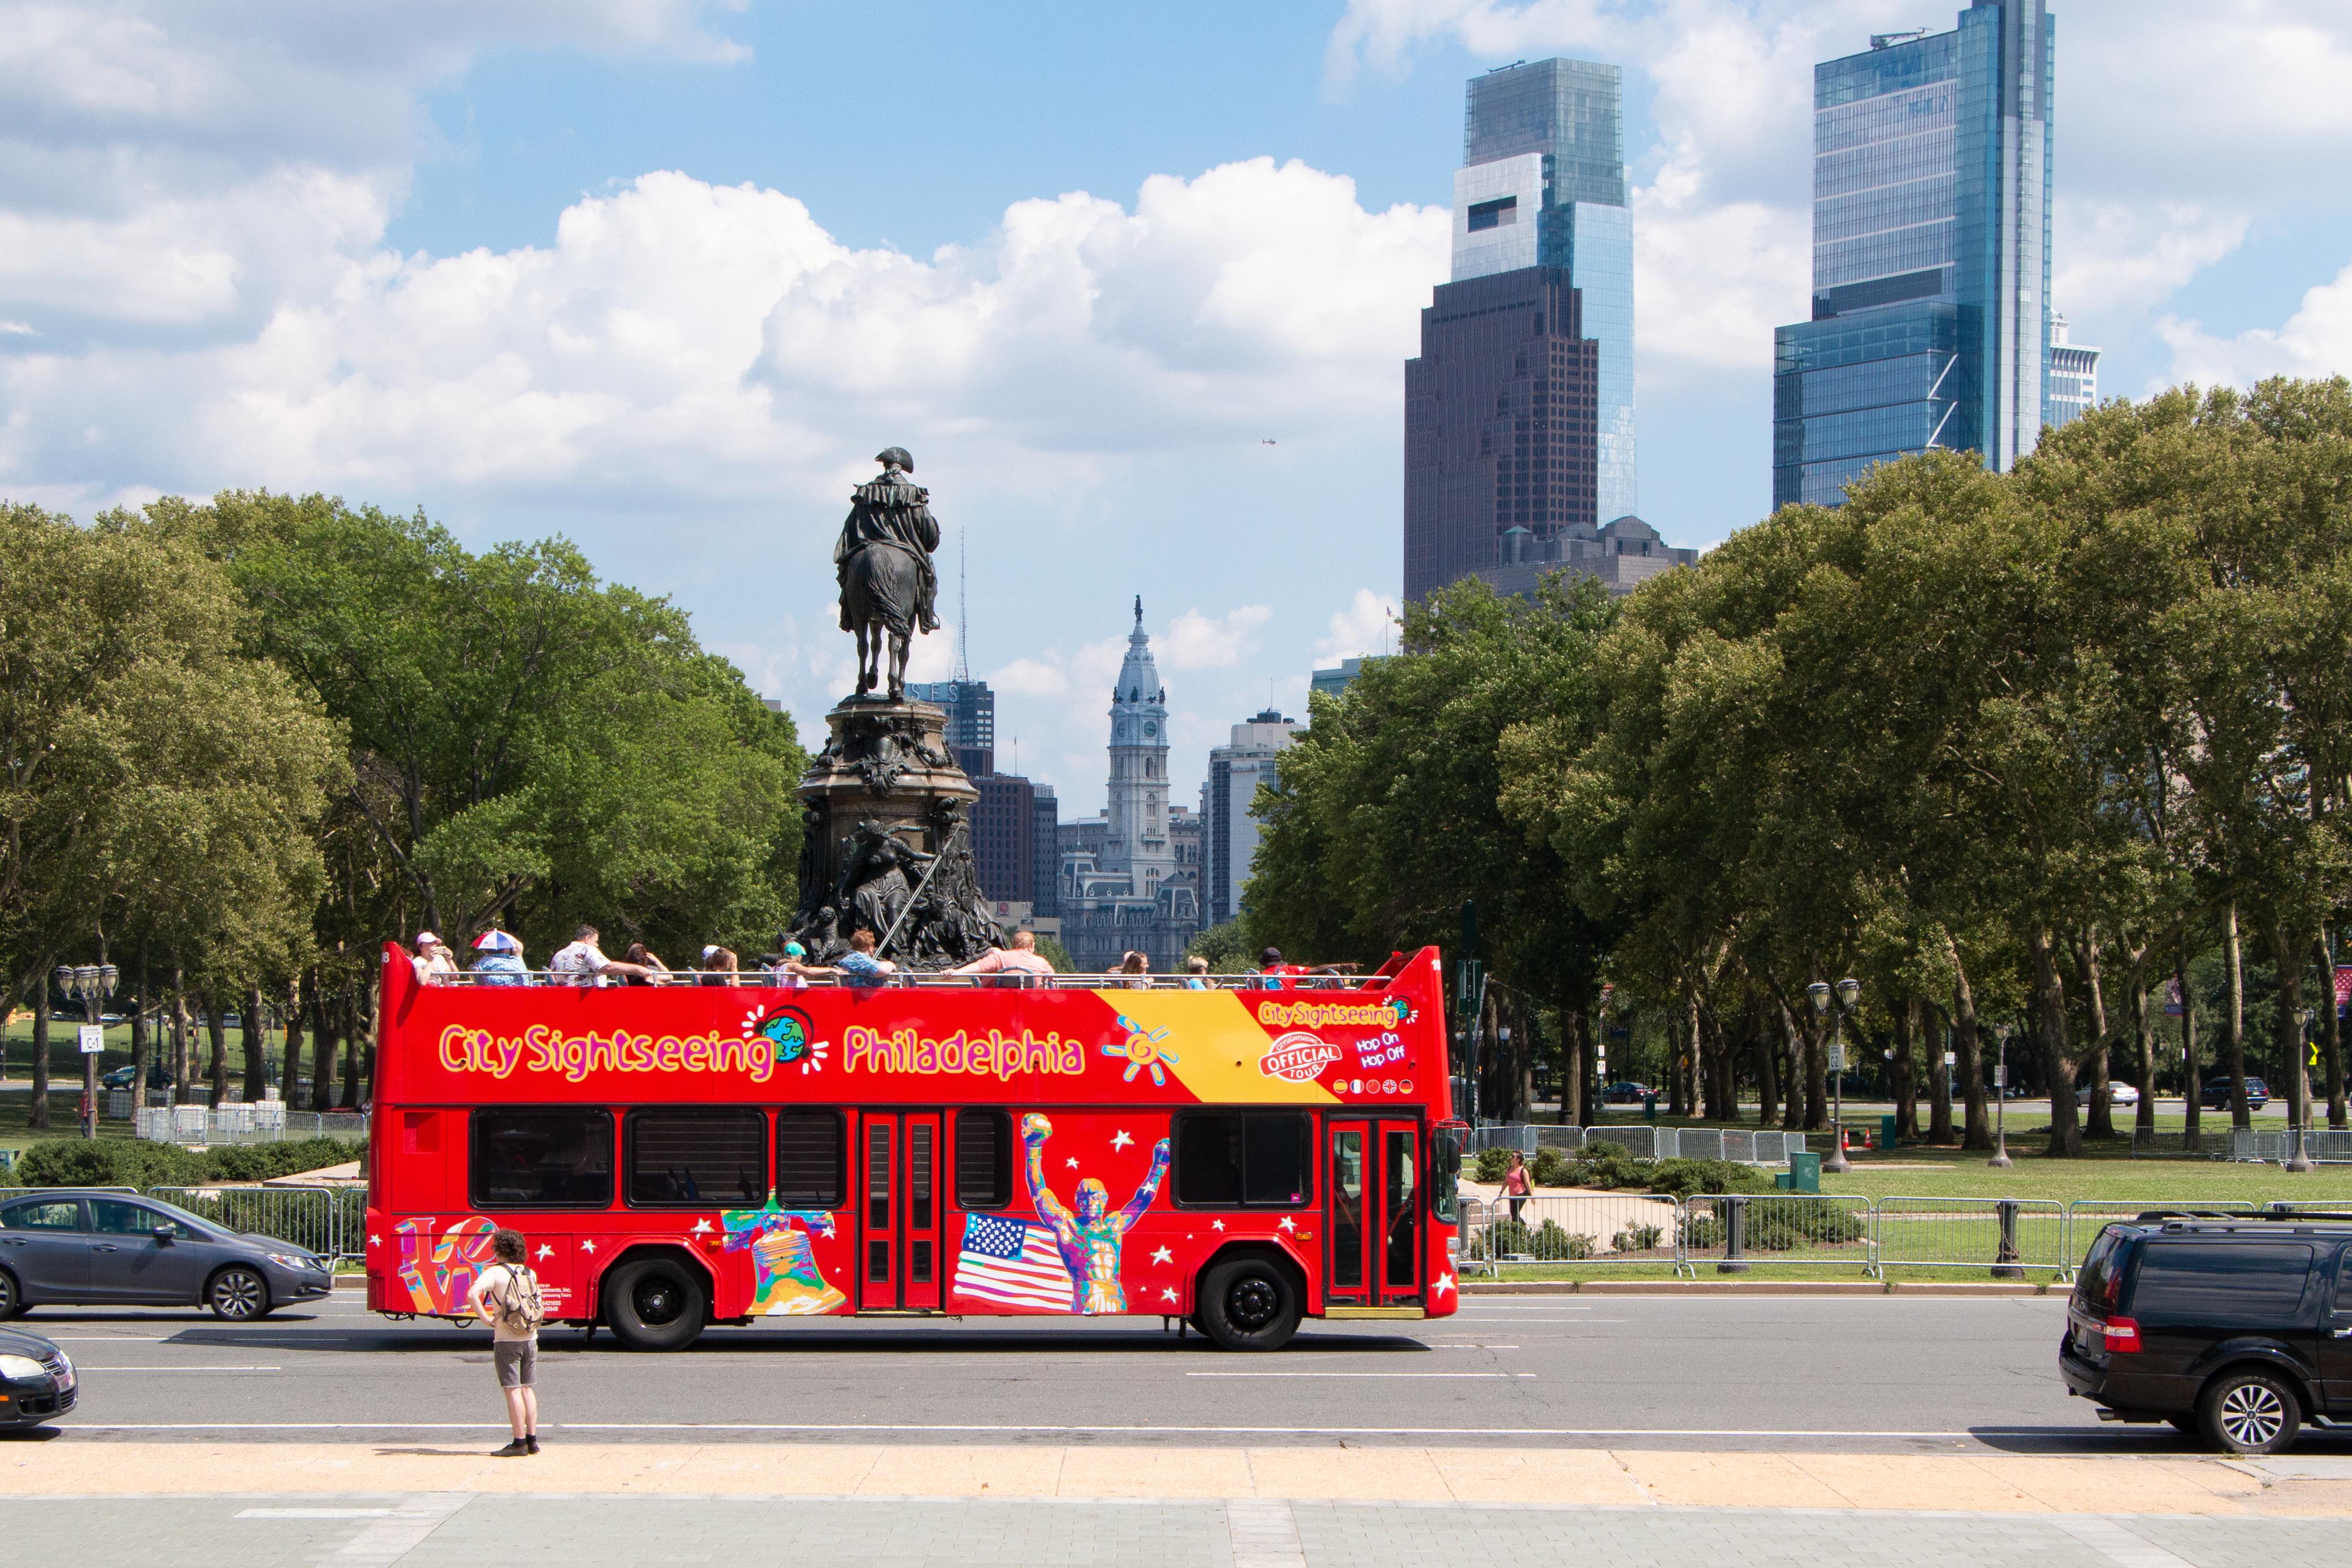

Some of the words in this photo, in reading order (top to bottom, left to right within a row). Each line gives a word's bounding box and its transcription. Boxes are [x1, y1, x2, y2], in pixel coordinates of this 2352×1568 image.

[843, 1025, 1086, 1081] Philadelphia
[1356, 1038, 1380, 1052] Hop
[1381, 1032, 1399, 1046] On
[1267, 1046, 1337, 1072] OFFICIAL
[1361, 1054, 1385, 1068] Hop
[1387, 1045, 1405, 1061] Off
[1289, 1064, 1321, 1078] TOUR
